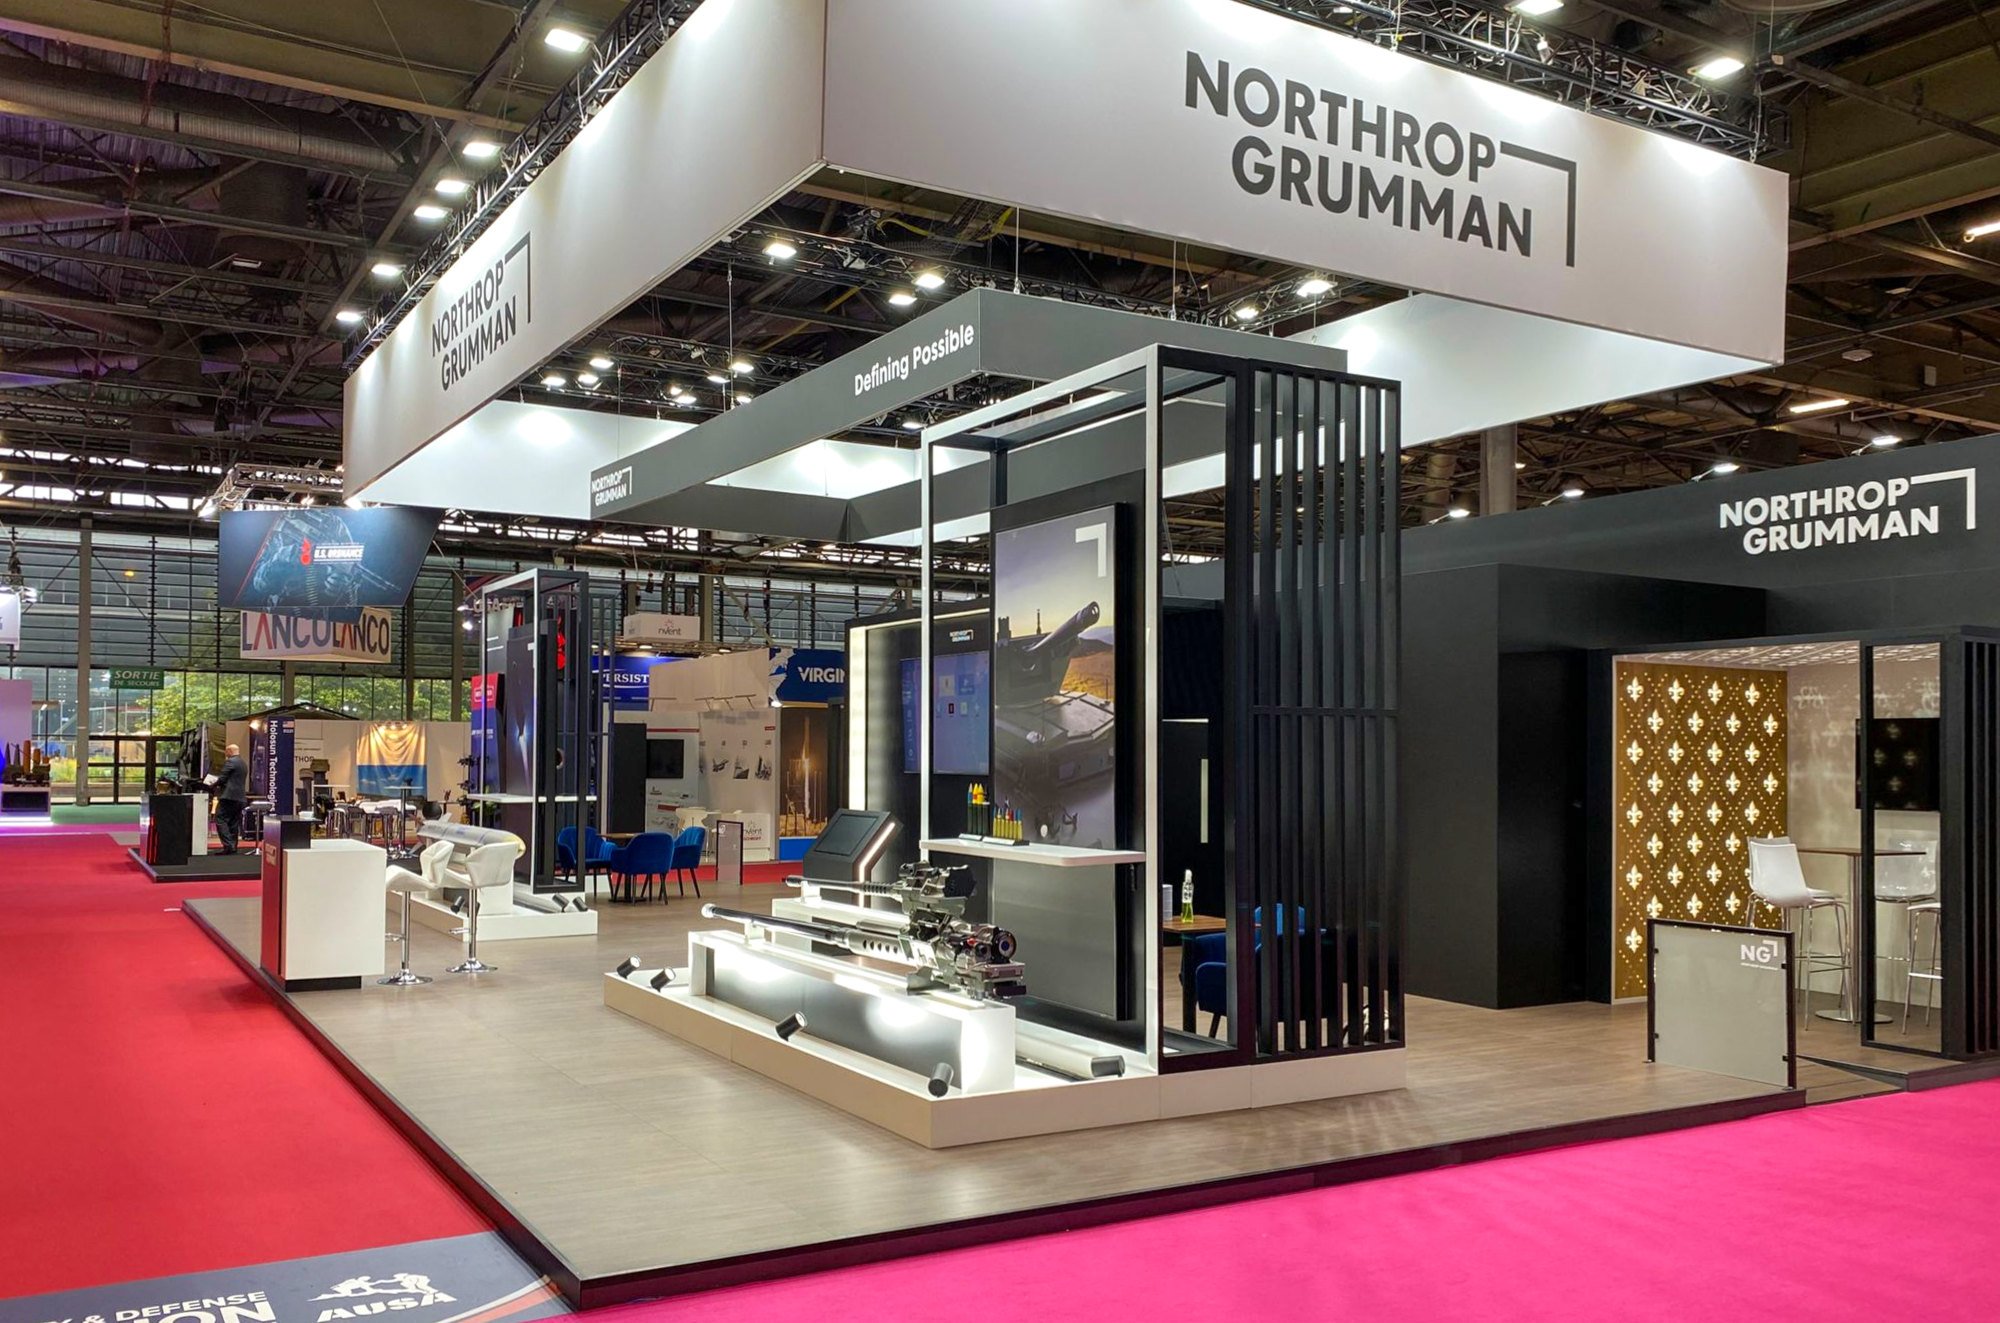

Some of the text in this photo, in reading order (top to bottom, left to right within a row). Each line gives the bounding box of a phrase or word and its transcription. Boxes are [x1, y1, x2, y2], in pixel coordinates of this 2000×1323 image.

[1185, 51, 1496, 183] NORTHROP
[1232, 135, 1532, 258] GRUMMAN
[432, 259, 504, 357] NORTHROP
[441, 295, 516, 391] GRUMMAN
[854, 324, 974, 396] Defining Possible
[1719, 477, 1909, 529] NORTHROP
[1743, 505, 1939, 555] GRUMMAN
[242, 612, 331, 651] LANCO
[114, 670, 160, 680] SORTIE
[269, 720, 278, 755] Holosun
[1741, 944, 1772, 963] NG
[115, 1291, 268, 1321] DEFENSE
[317, 1291, 458, 1322] AUSA
